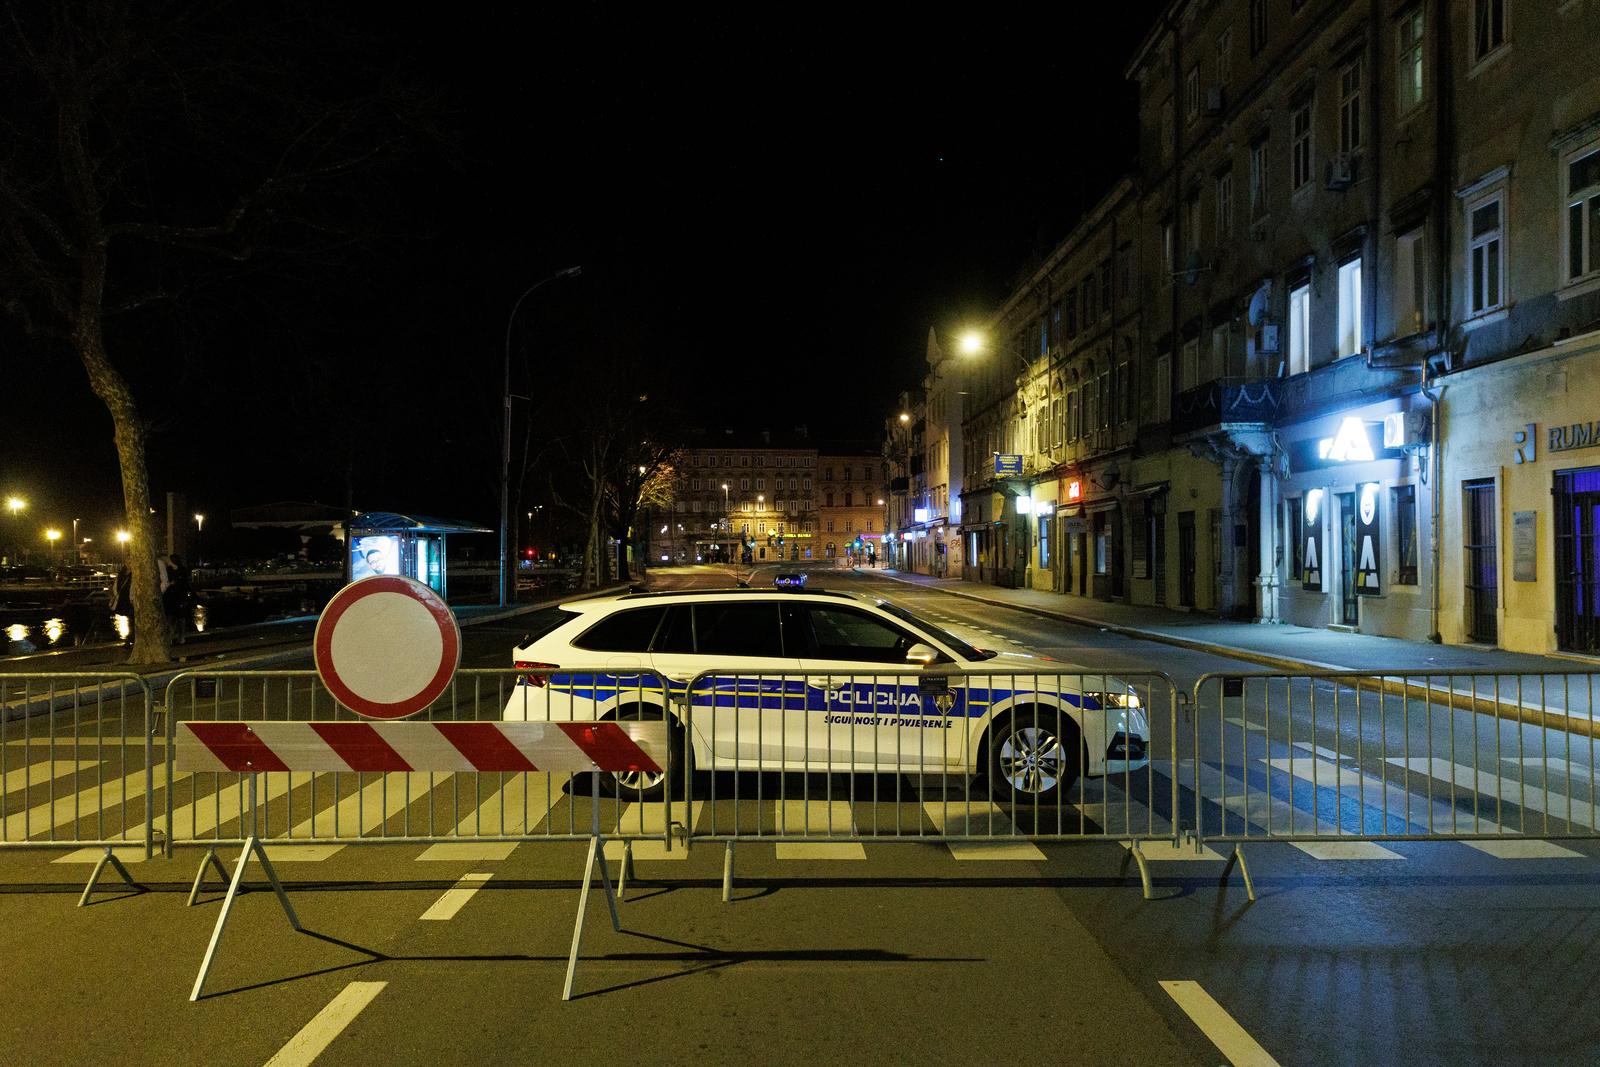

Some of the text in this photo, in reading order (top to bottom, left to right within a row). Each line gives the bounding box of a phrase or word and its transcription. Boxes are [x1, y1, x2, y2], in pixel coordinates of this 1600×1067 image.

[824, 690, 922, 707] POLICIJA
[884, 717, 889, 726] I
[890, 718, 952, 728] POVJERENE
